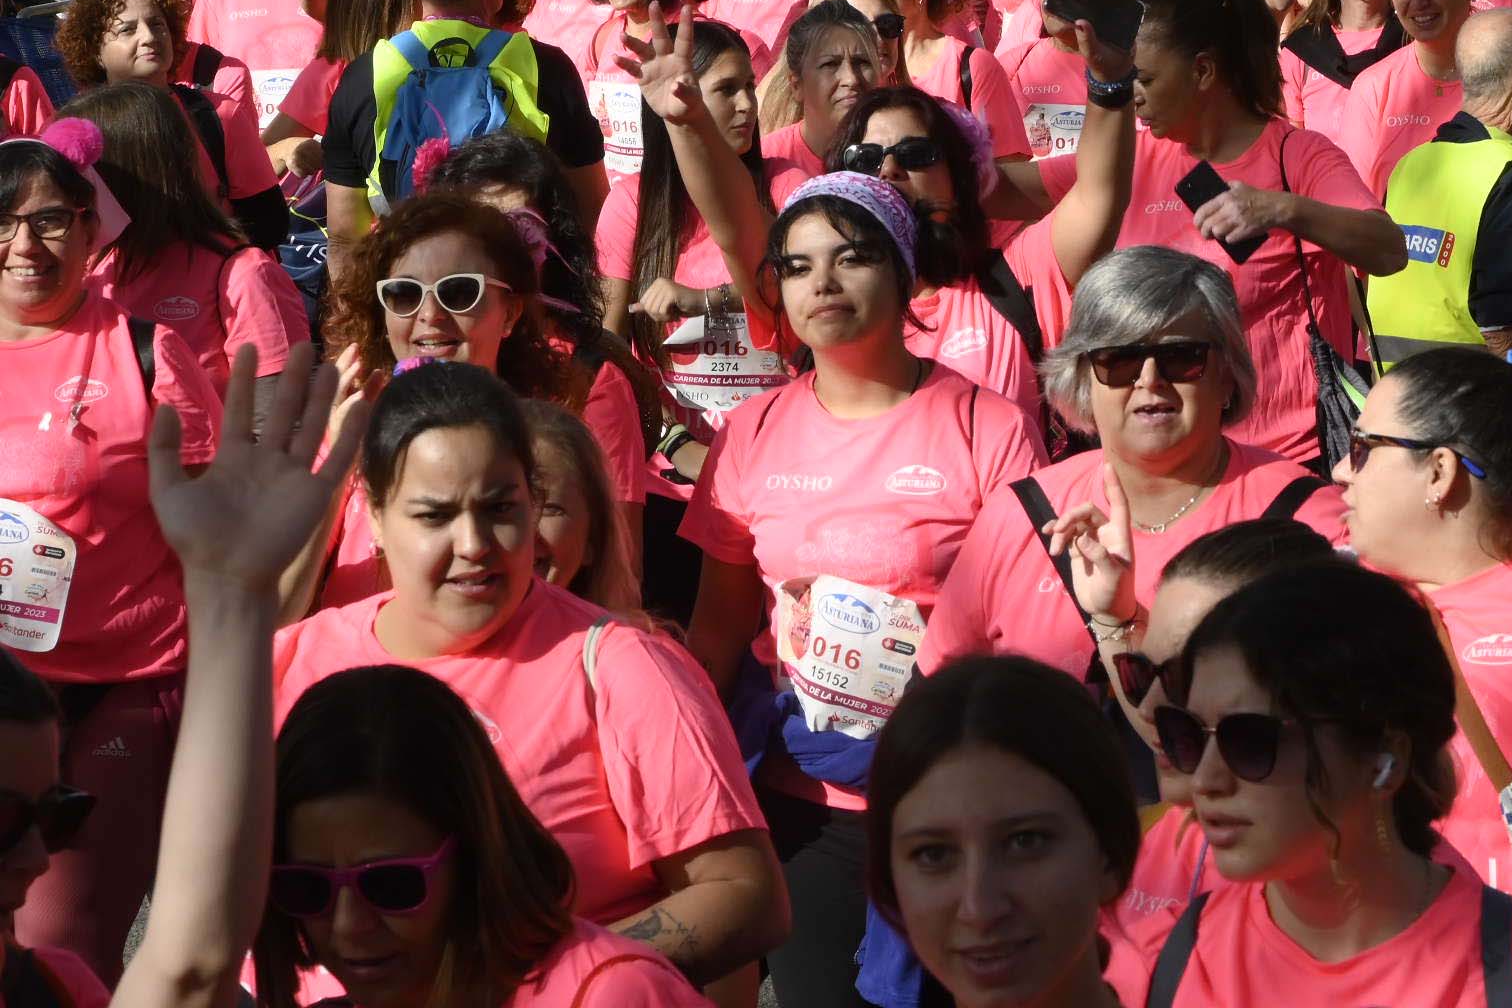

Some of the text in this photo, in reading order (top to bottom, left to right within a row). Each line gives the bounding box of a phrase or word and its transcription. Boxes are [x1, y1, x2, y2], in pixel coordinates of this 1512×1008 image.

[613, 120, 638, 133] 016
[1440, 234, 1455, 266] 2000
[703, 341, 748, 356] 016
[711, 362, 739, 372] 2374
[674, 375, 708, 384] CARRERA
[767, 474, 832, 492] OYSHO
[24, 608, 47, 619] 2023
[825, 601, 874, 631] ASTURIANA
[888, 618, 921, 633] SUMA
[813, 636, 862, 671] 016
[811, 665, 849, 690] 15152
[821, 690, 832, 701] LA
[834, 693, 868, 711] MUJER
